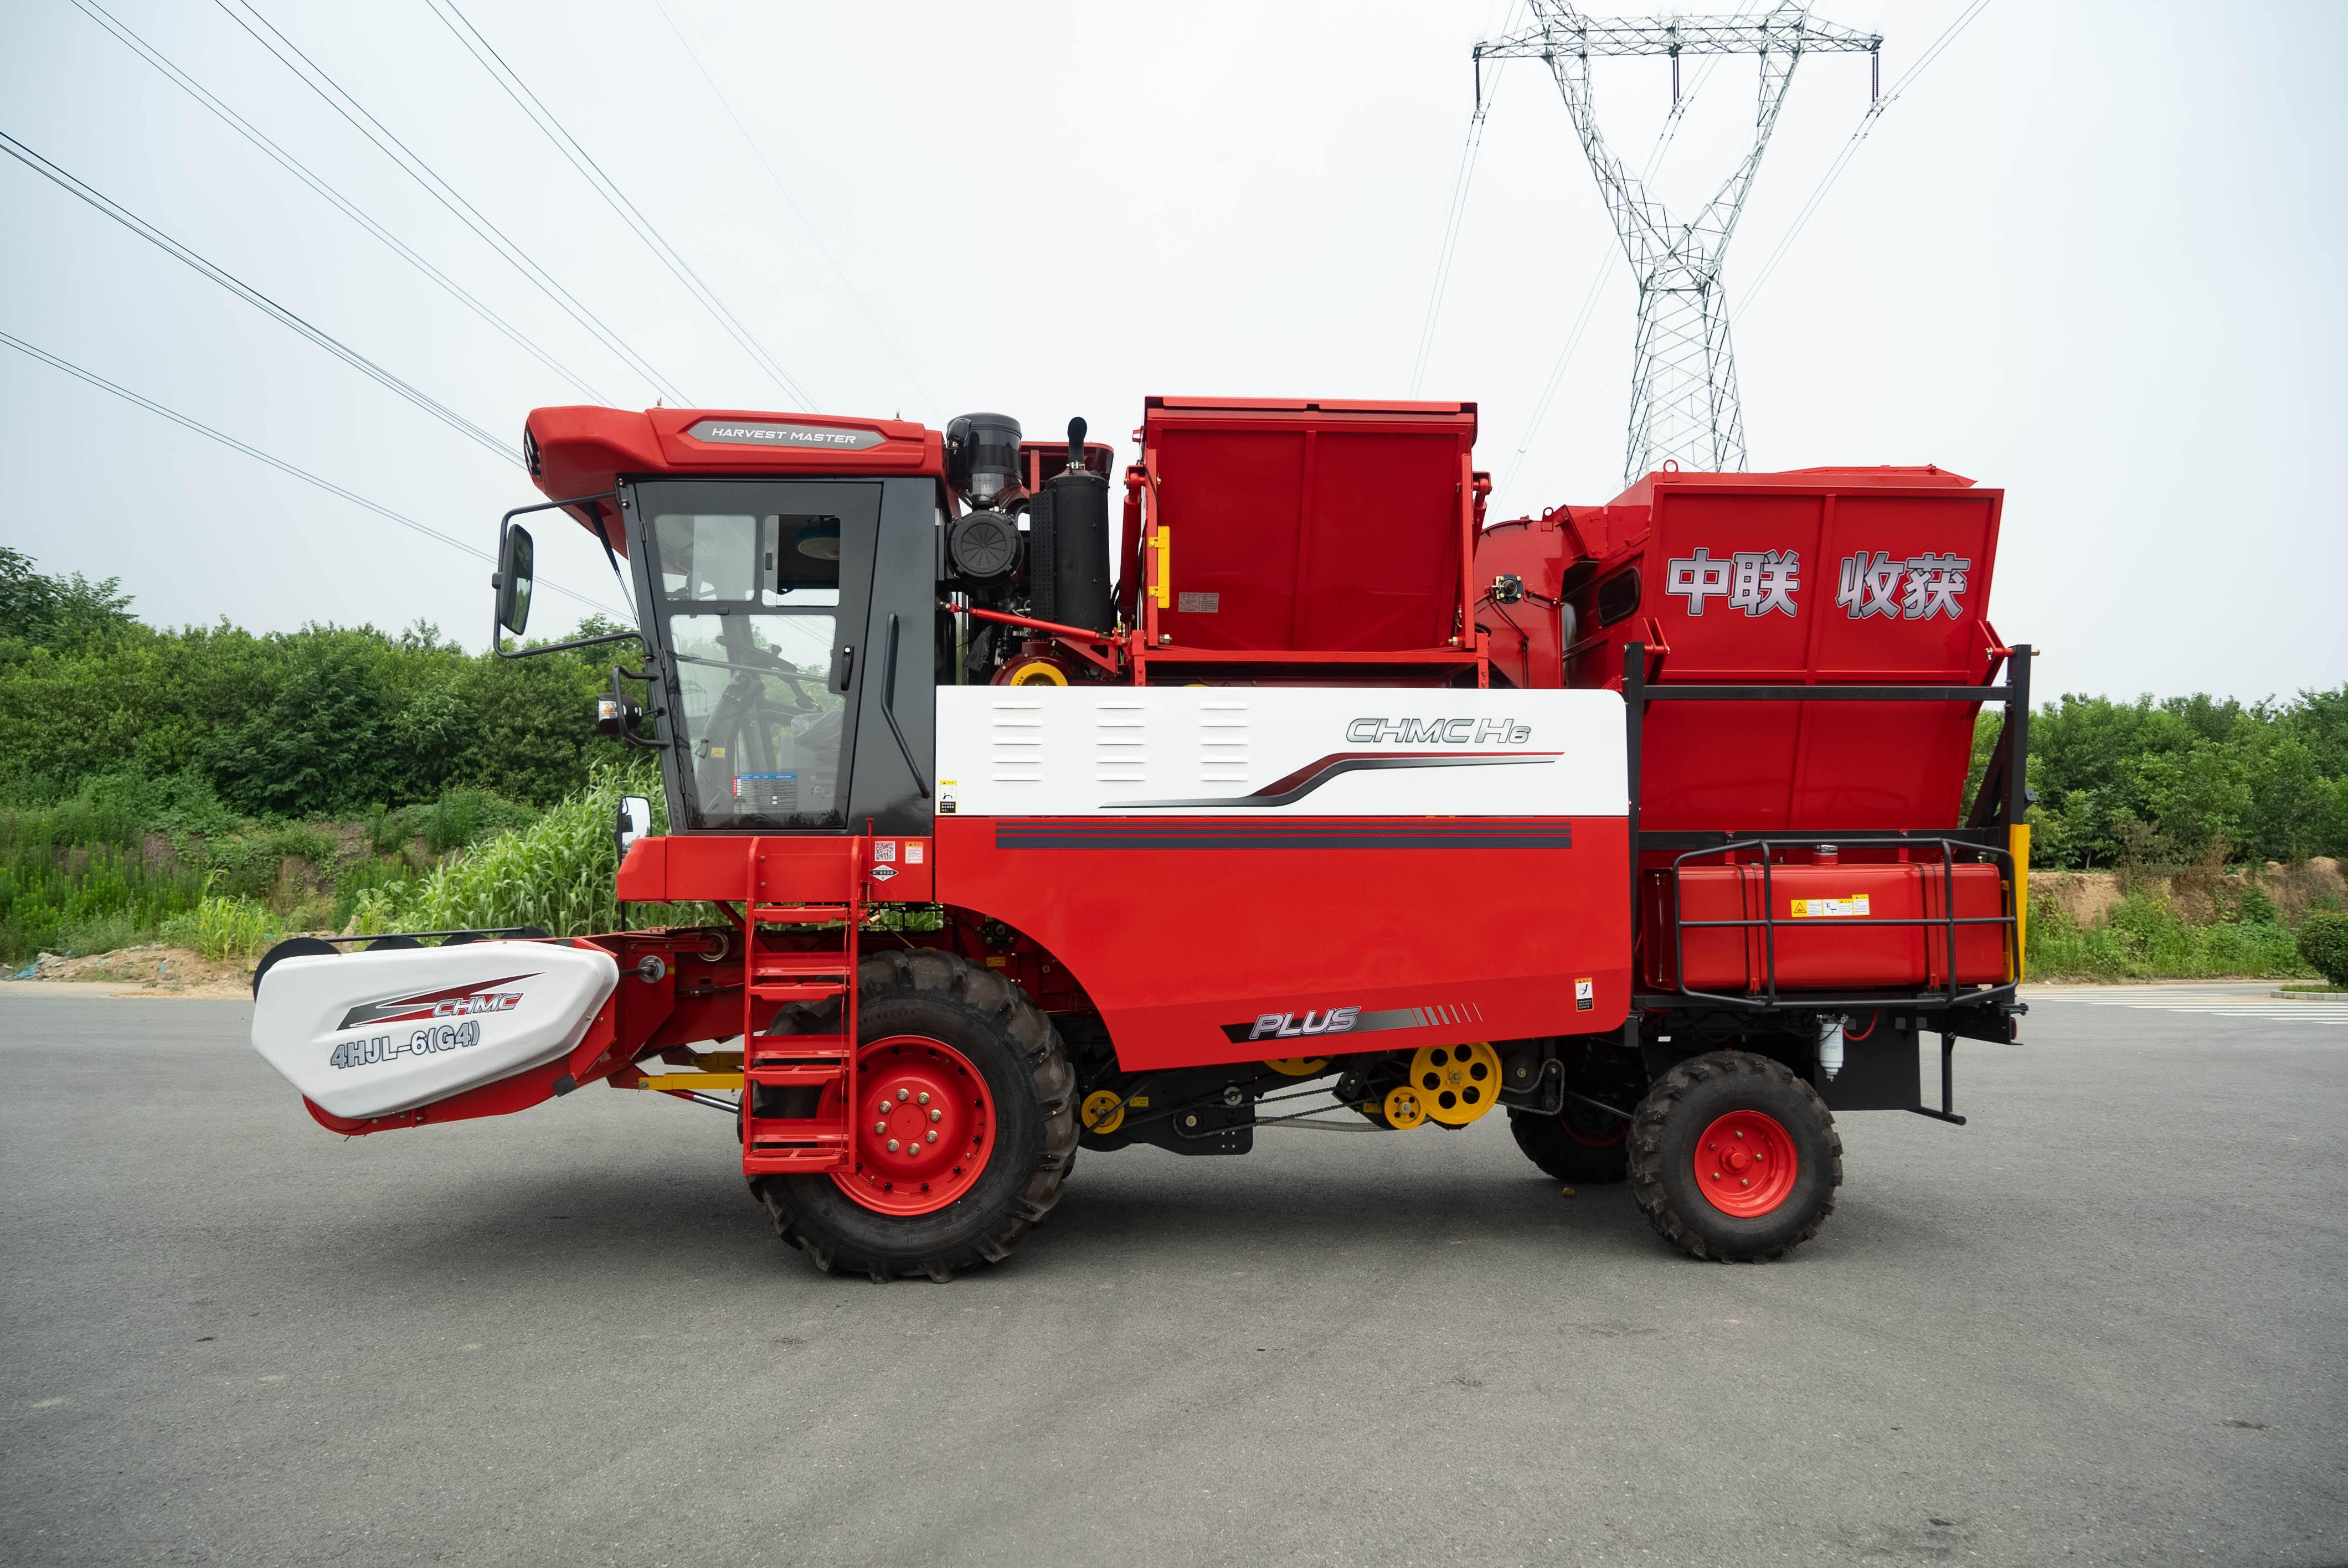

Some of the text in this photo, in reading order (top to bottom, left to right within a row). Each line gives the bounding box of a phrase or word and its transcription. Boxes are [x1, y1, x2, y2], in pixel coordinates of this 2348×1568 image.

[712, 428, 856, 443] HARVEST MASTER
[1665, 547, 1971, 621] 中联 收获
[1346, 718, 1531, 744] CHMC H6
[432, 992, 521, 1018] CHMC
[1249, 1006, 1361, 1039] PLUS
[331, 1021, 480, 1069] 4HJL-6(G4)
